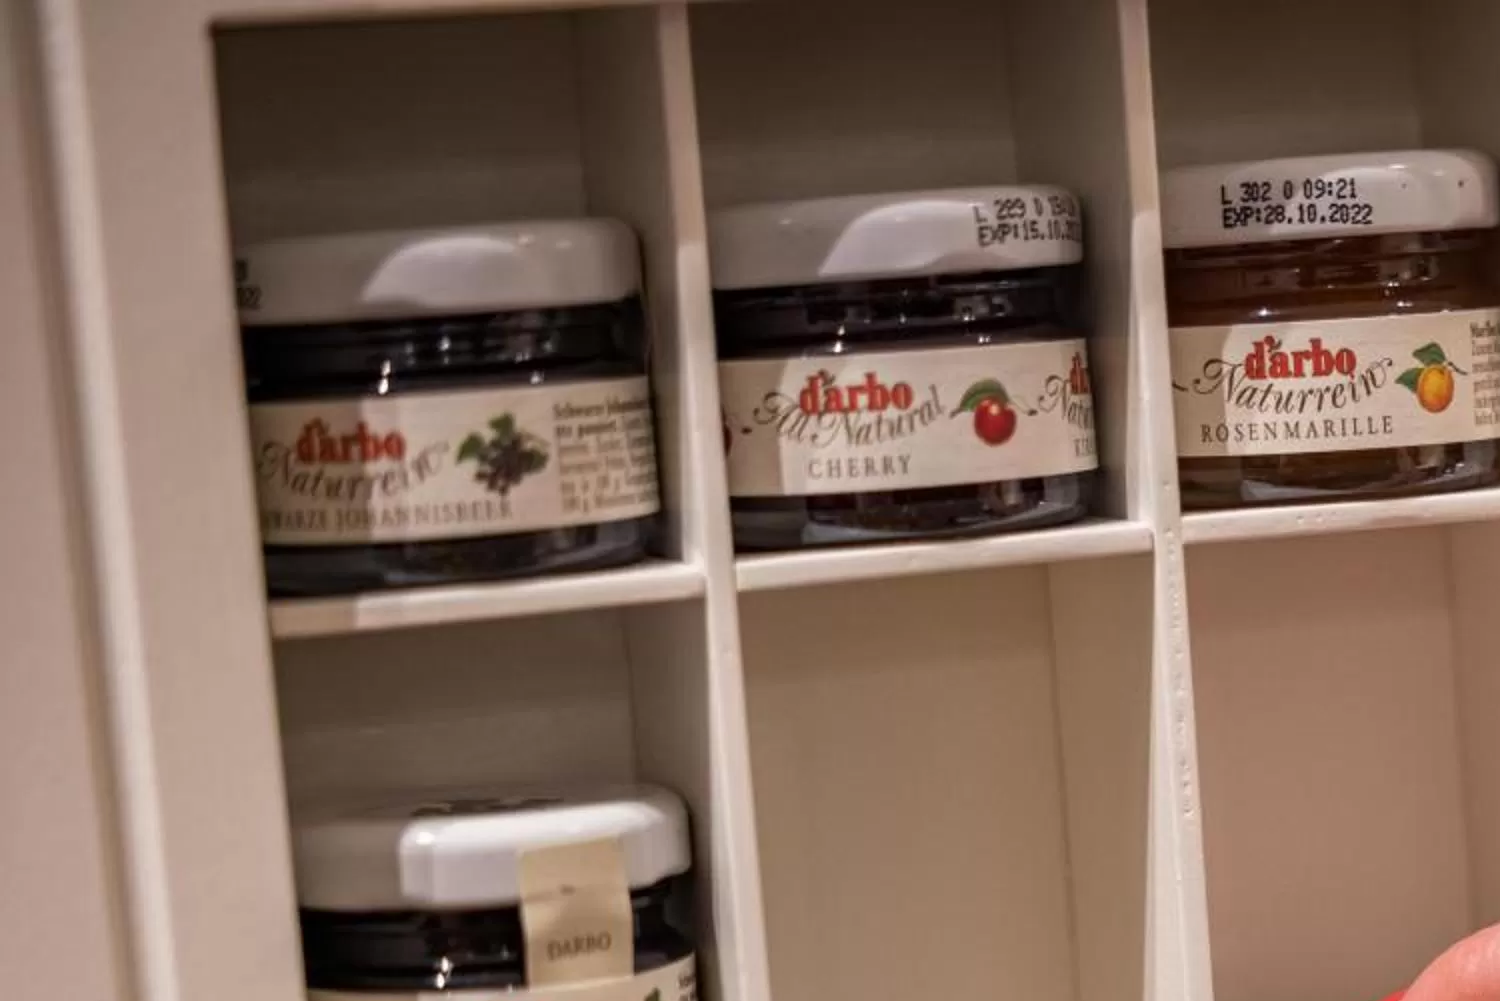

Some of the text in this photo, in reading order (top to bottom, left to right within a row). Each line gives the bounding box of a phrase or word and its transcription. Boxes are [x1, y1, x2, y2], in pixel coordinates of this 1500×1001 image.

[1221, 185, 1233, 205] L
[1240, 181, 1271, 202] 302
[1304, 177, 1357, 200] 09:21
[973, 205, 988, 223] L
[1222, 203, 1373, 229] EXP:28.10.2022
[1192, 357, 1393, 415] Naturrein
[811, 383, 948, 448] Natural
[1200, 415, 1393, 444] ROSENMARILLE
[808, 454, 913, 480] CHERRY
[337, 499, 514, 532] JOHANNISBEER
[547, 932, 612, 960] DARBO
